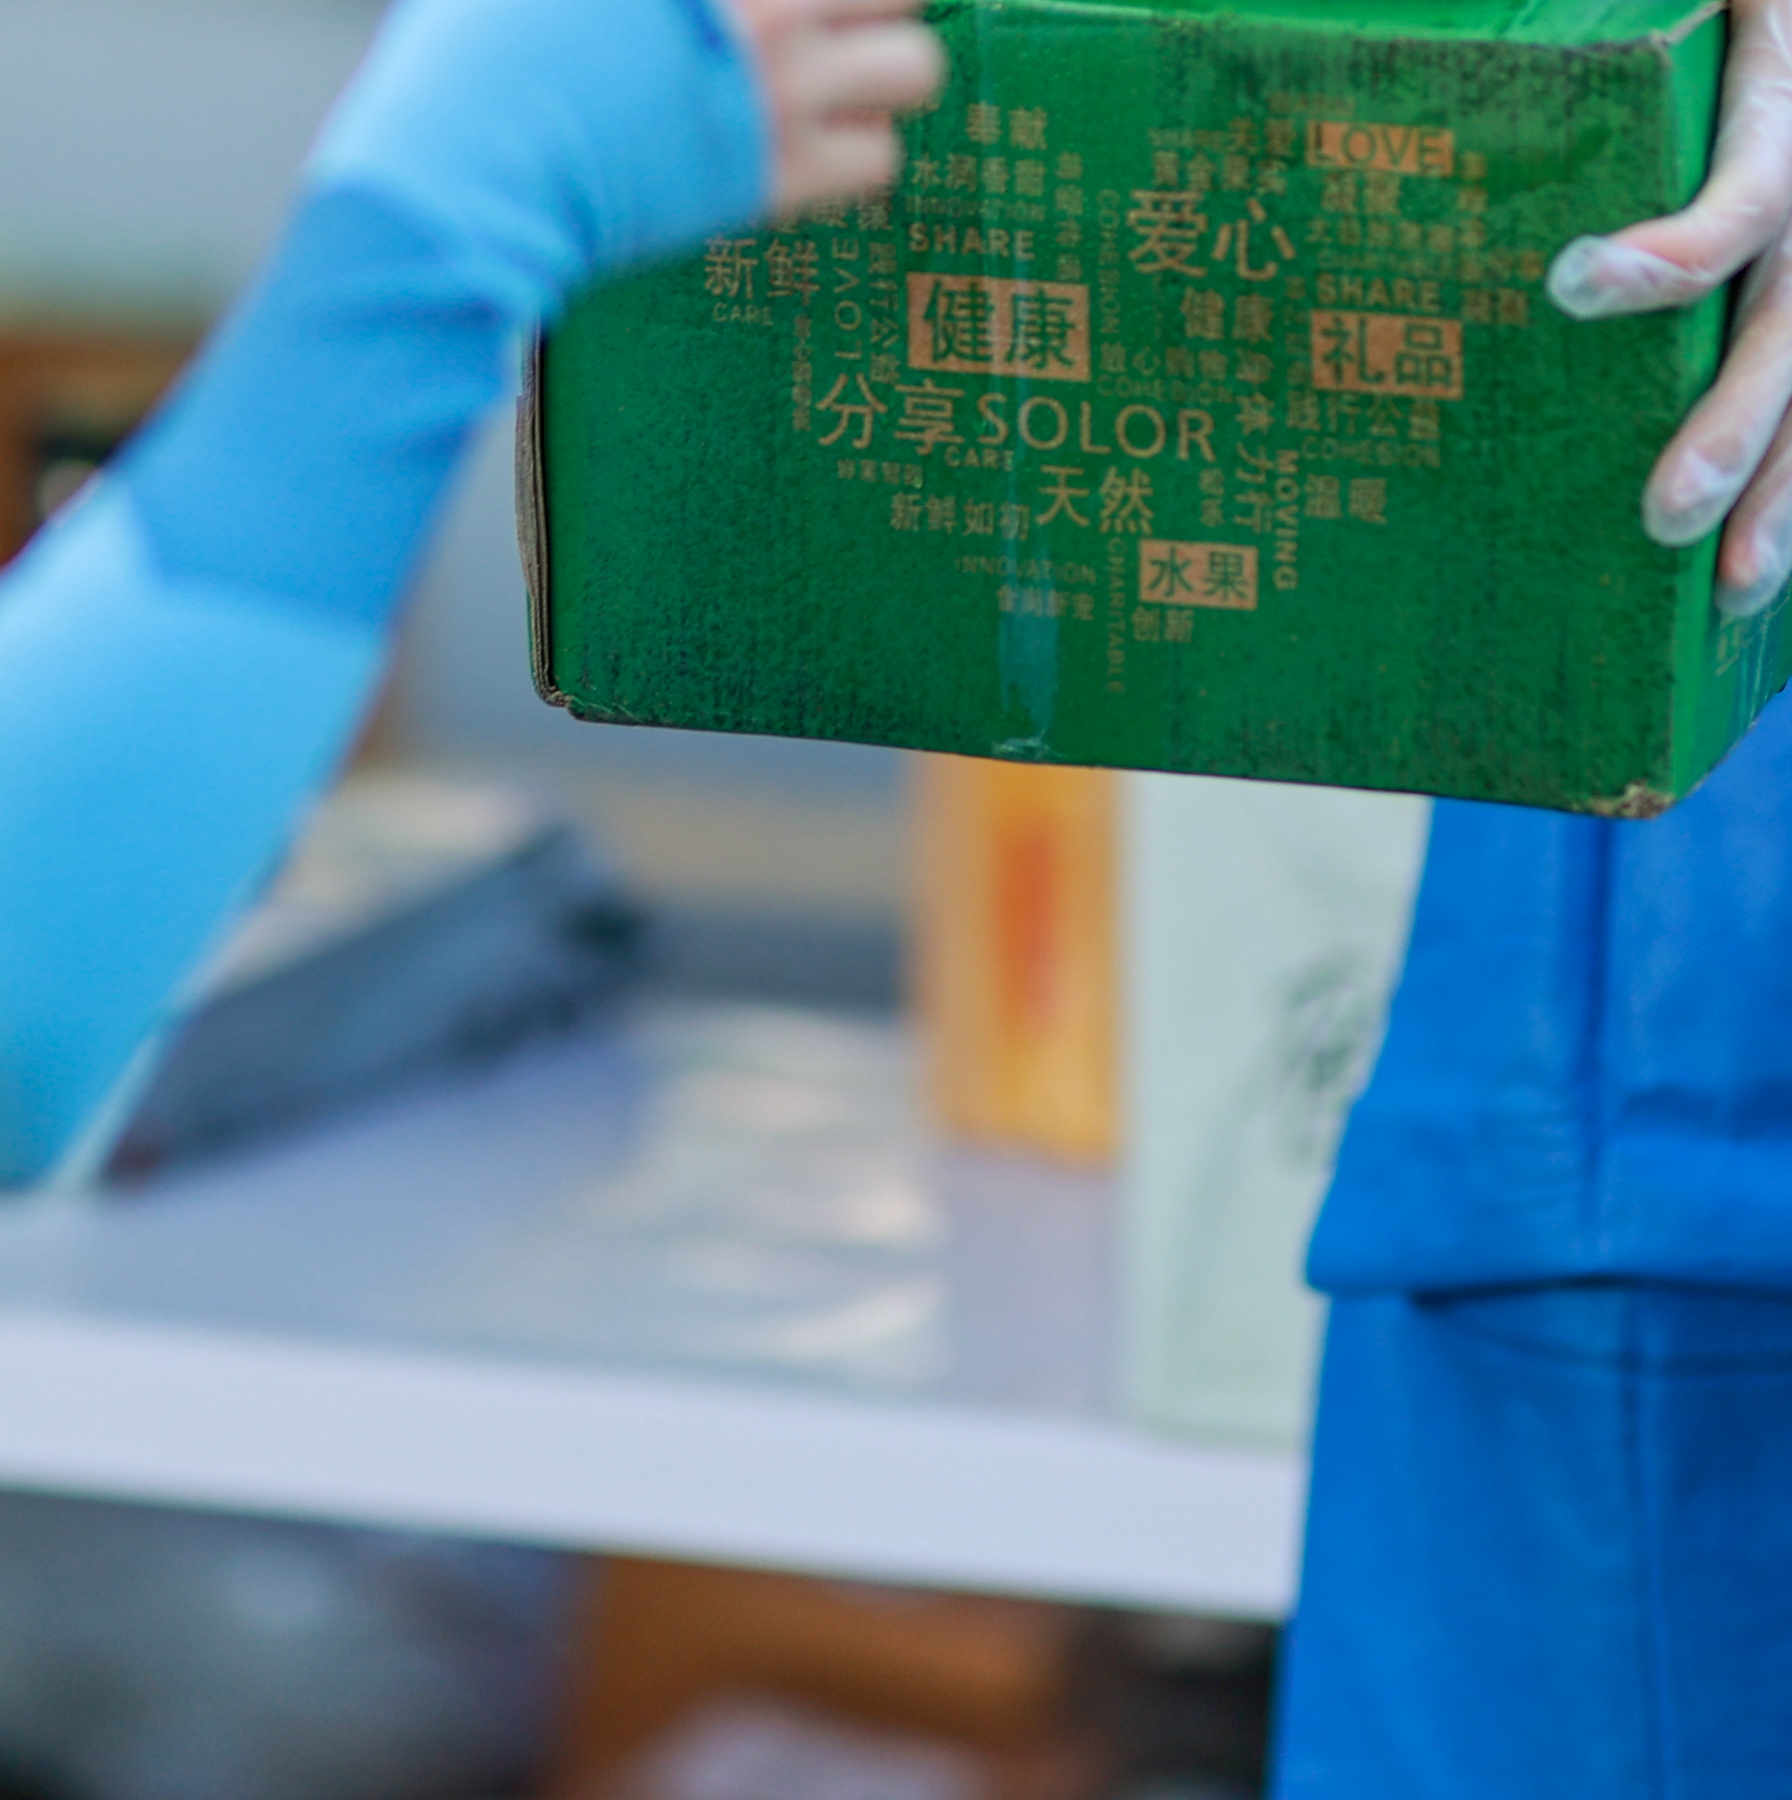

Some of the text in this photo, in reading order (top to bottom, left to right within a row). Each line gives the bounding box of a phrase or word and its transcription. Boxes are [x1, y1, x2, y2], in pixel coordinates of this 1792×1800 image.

[1312, 124, 1452, 176] LOVE
[909, 222, 1036, 261] SHARE
[1126, 188, 1296, 282] 爱心
[704, 237, 821, 306] 新鲜
[831, 235, 864, 361] LOVE
[1315, 272, 1442, 312] SHARE
[712, 301, 774, 327] CARE
[922, 278, 1078, 374] 健康
[1319, 314, 1454, 390] 礼品
[814, 372, 966, 456] 分享
[975, 391, 1217, 462] SOLOR
[944, 445, 1015, 471] CARE
[1034, 463, 1155, 534] 天然
[1273, 448, 1300, 591] MOVING
[954, 554, 1099, 587] INNOVATION
[1147, 545, 1252, 601] 水果
